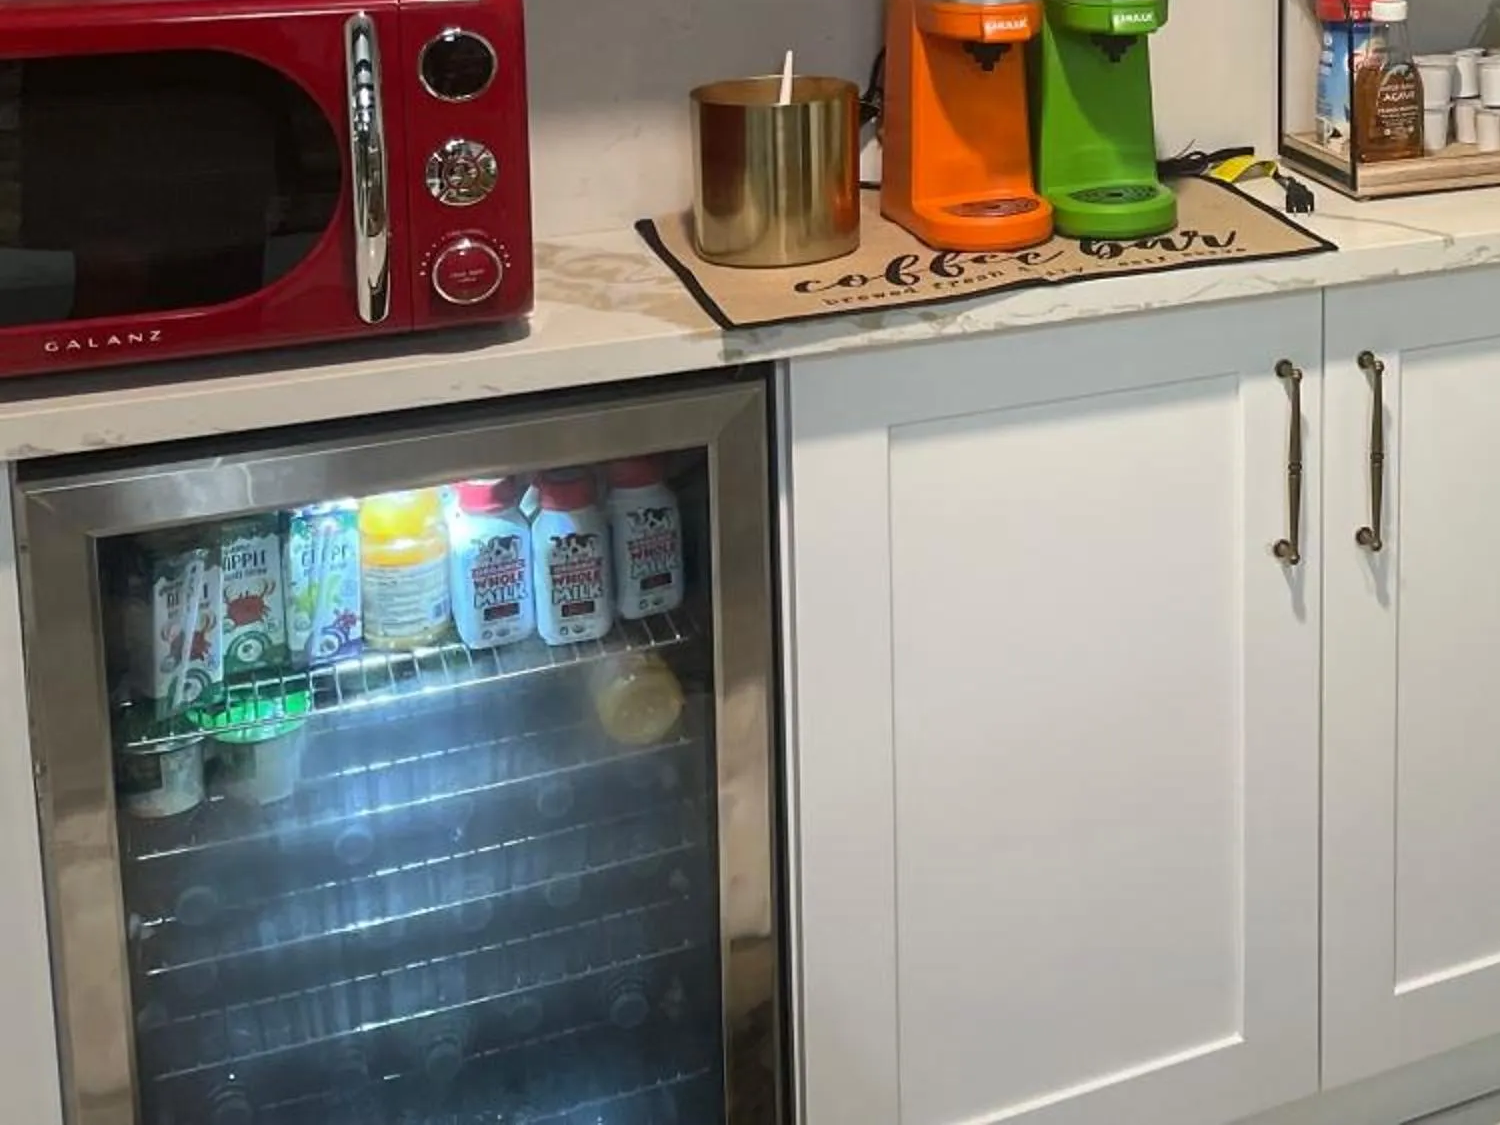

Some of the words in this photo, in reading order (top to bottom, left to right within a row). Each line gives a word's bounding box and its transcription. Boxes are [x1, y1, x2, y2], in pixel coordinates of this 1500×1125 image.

[794, 251, 1064, 293] coffee
[44, 330, 161, 352] GALANZ
[472, 570, 525, 589] WHOLE
[552, 569, 602, 586] WHOLE
[473, 583, 529, 610] MILK
[551, 583, 604, 606] MILK
